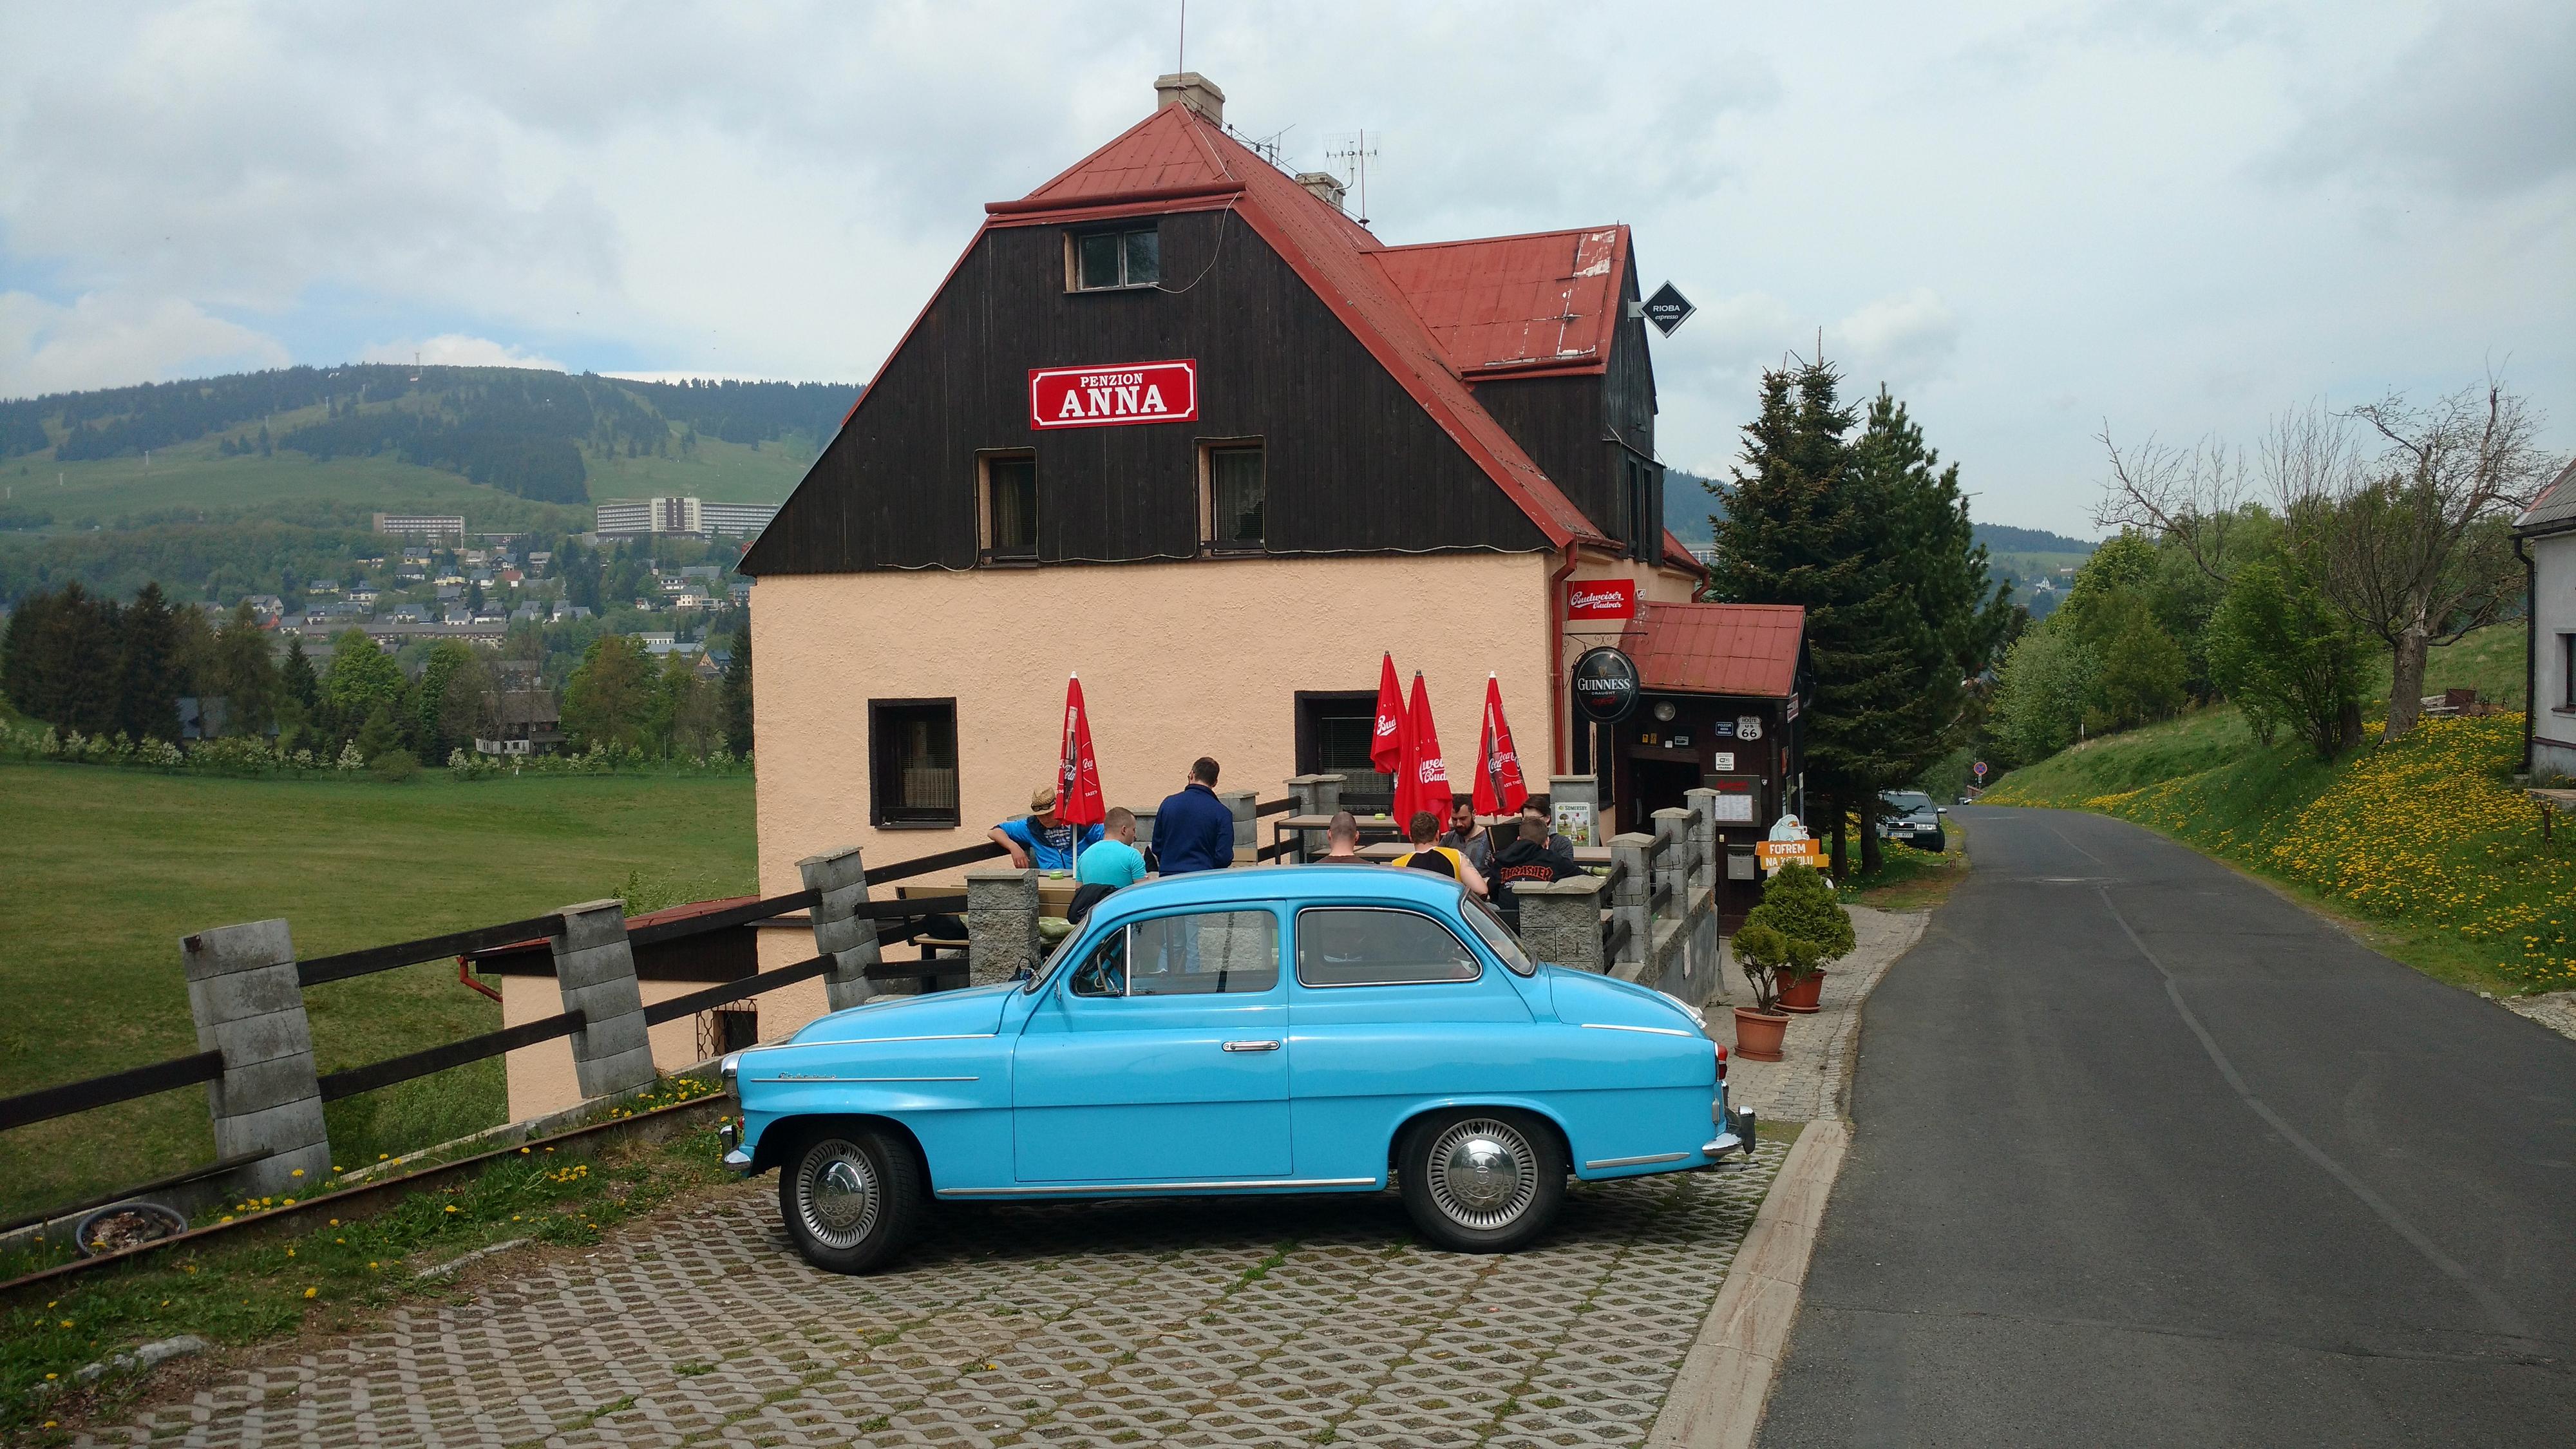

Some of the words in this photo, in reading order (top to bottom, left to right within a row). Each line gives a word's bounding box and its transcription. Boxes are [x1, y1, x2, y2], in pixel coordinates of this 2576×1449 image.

[1080, 373, 1143, 387] PENZION
[1059, 384, 1167, 418] ANNA
[1571, 591, 1624, 607] Budweiser
[1593, 600, 1622, 609] Budvar
[1577, 677, 1631, 690] GUINNESS
[1741, 729, 1757, 737] 66
[1769, 843, 1806, 854] FOFREM
[1765, 857, 1778, 866] NA
[1501, 865, 1553, 884] THRASHER
